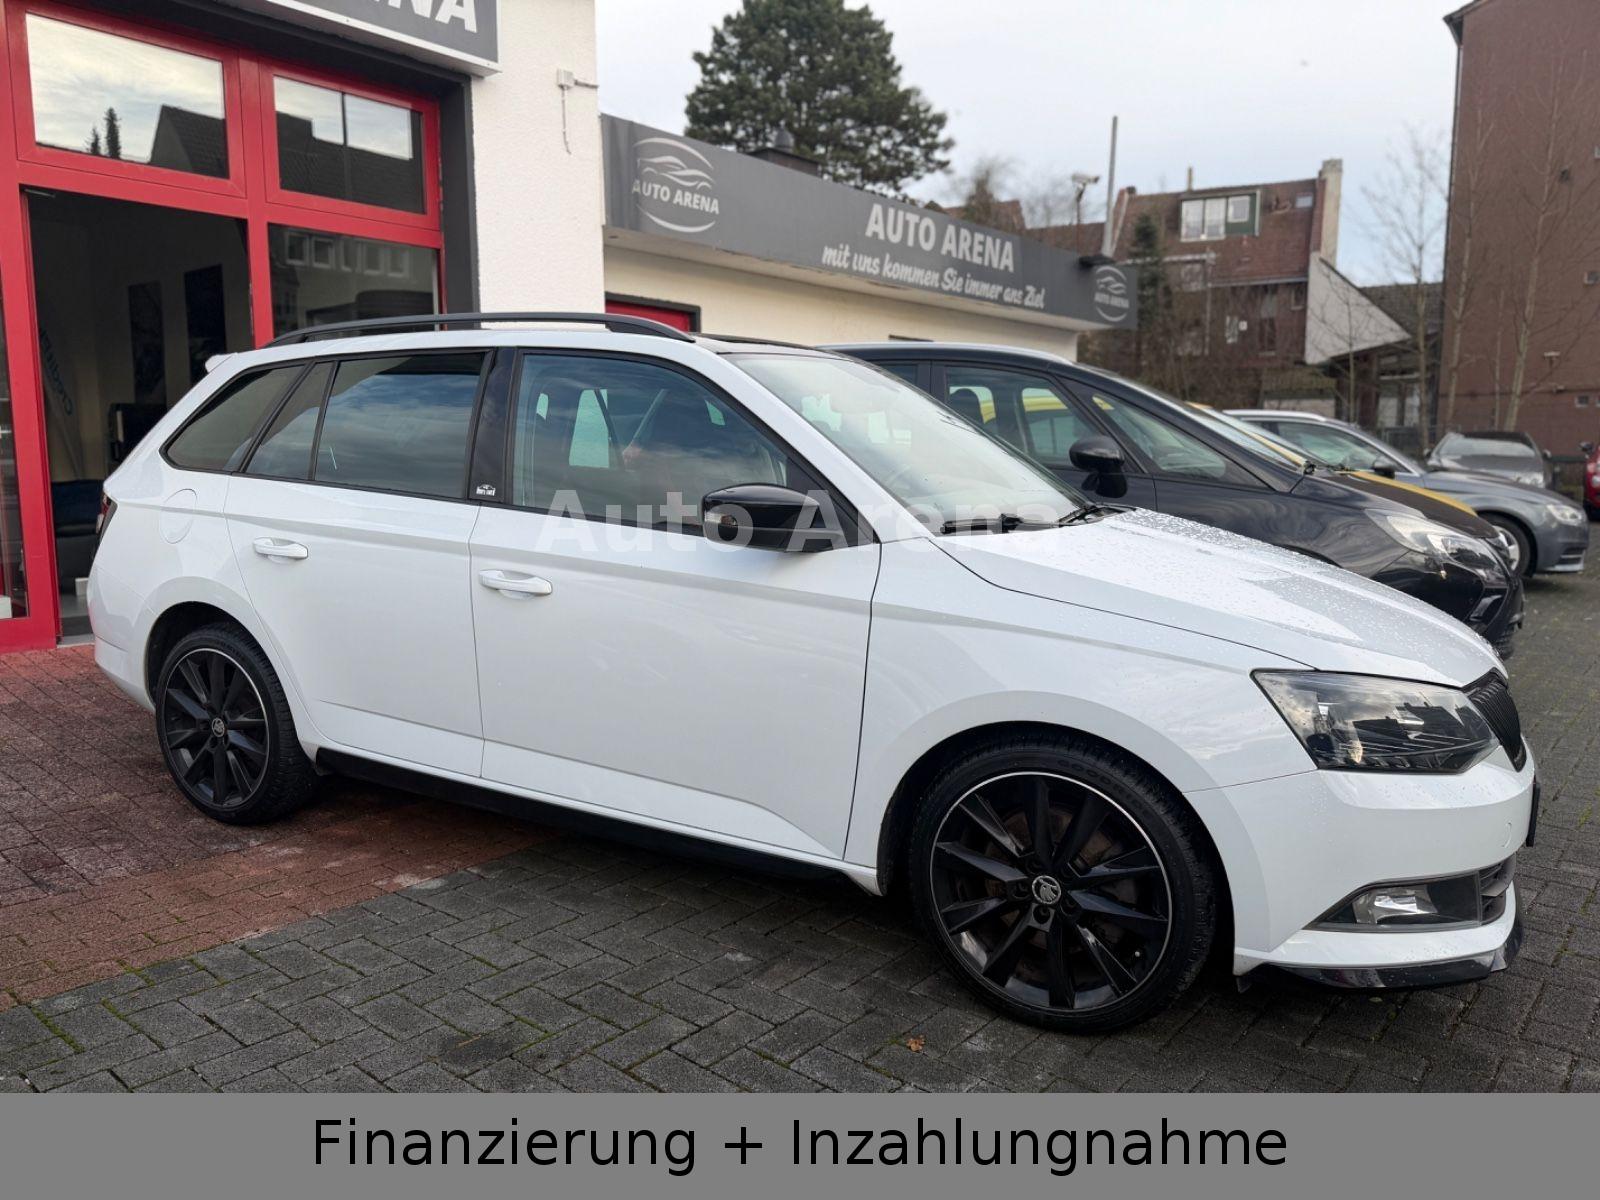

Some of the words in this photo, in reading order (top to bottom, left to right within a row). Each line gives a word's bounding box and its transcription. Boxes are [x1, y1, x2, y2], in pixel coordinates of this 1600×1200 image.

[632, 179, 670, 202] AUTO
[672, 189, 719, 215] ARENA
[865, 203, 936, 252] AUTO
[941, 224, 1014, 273] ARENA
[822, 243, 850, 269] mit
[852, 252, 881, 275] uns
[883, 253, 940, 288] kommen
[941, 267, 964, 292] Sie
[965, 273, 1003, 300] immer
[1024, 285, 1045, 309] Ziel
